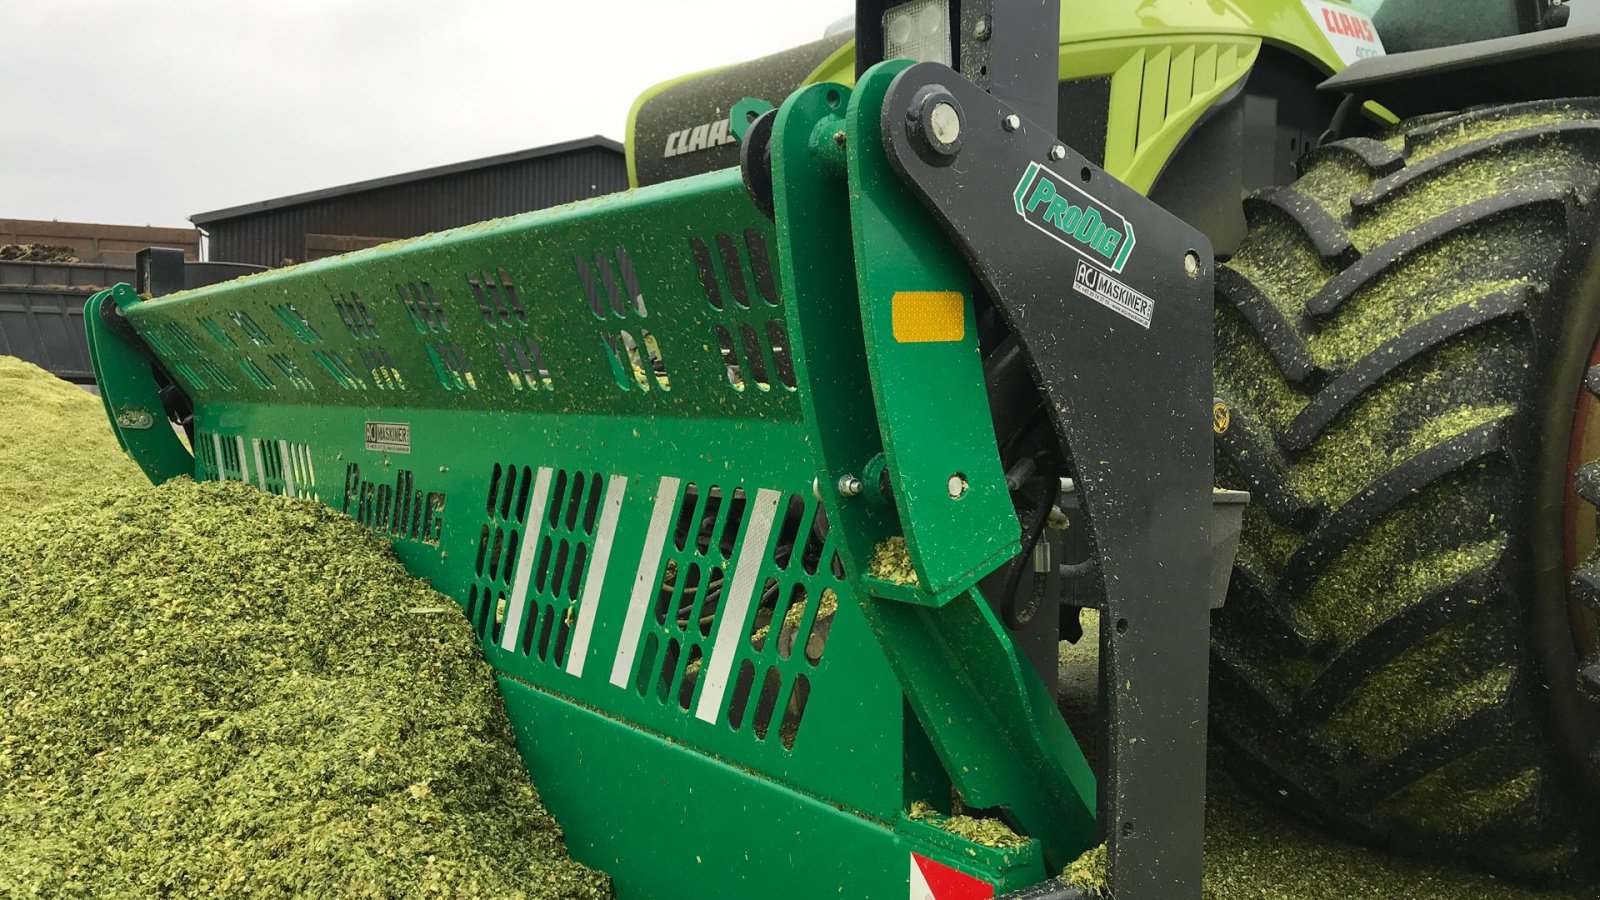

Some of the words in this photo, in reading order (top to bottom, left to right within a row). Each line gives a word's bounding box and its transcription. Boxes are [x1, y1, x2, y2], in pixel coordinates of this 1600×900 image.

[1321, 8, 1374, 42] CLAAS
[664, 119, 737, 157] CLAA
[1077, 264, 1097, 288] ACJ
[1098, 277, 1148, 315] MASKINER
[377, 427, 407, 442] MASKINER
